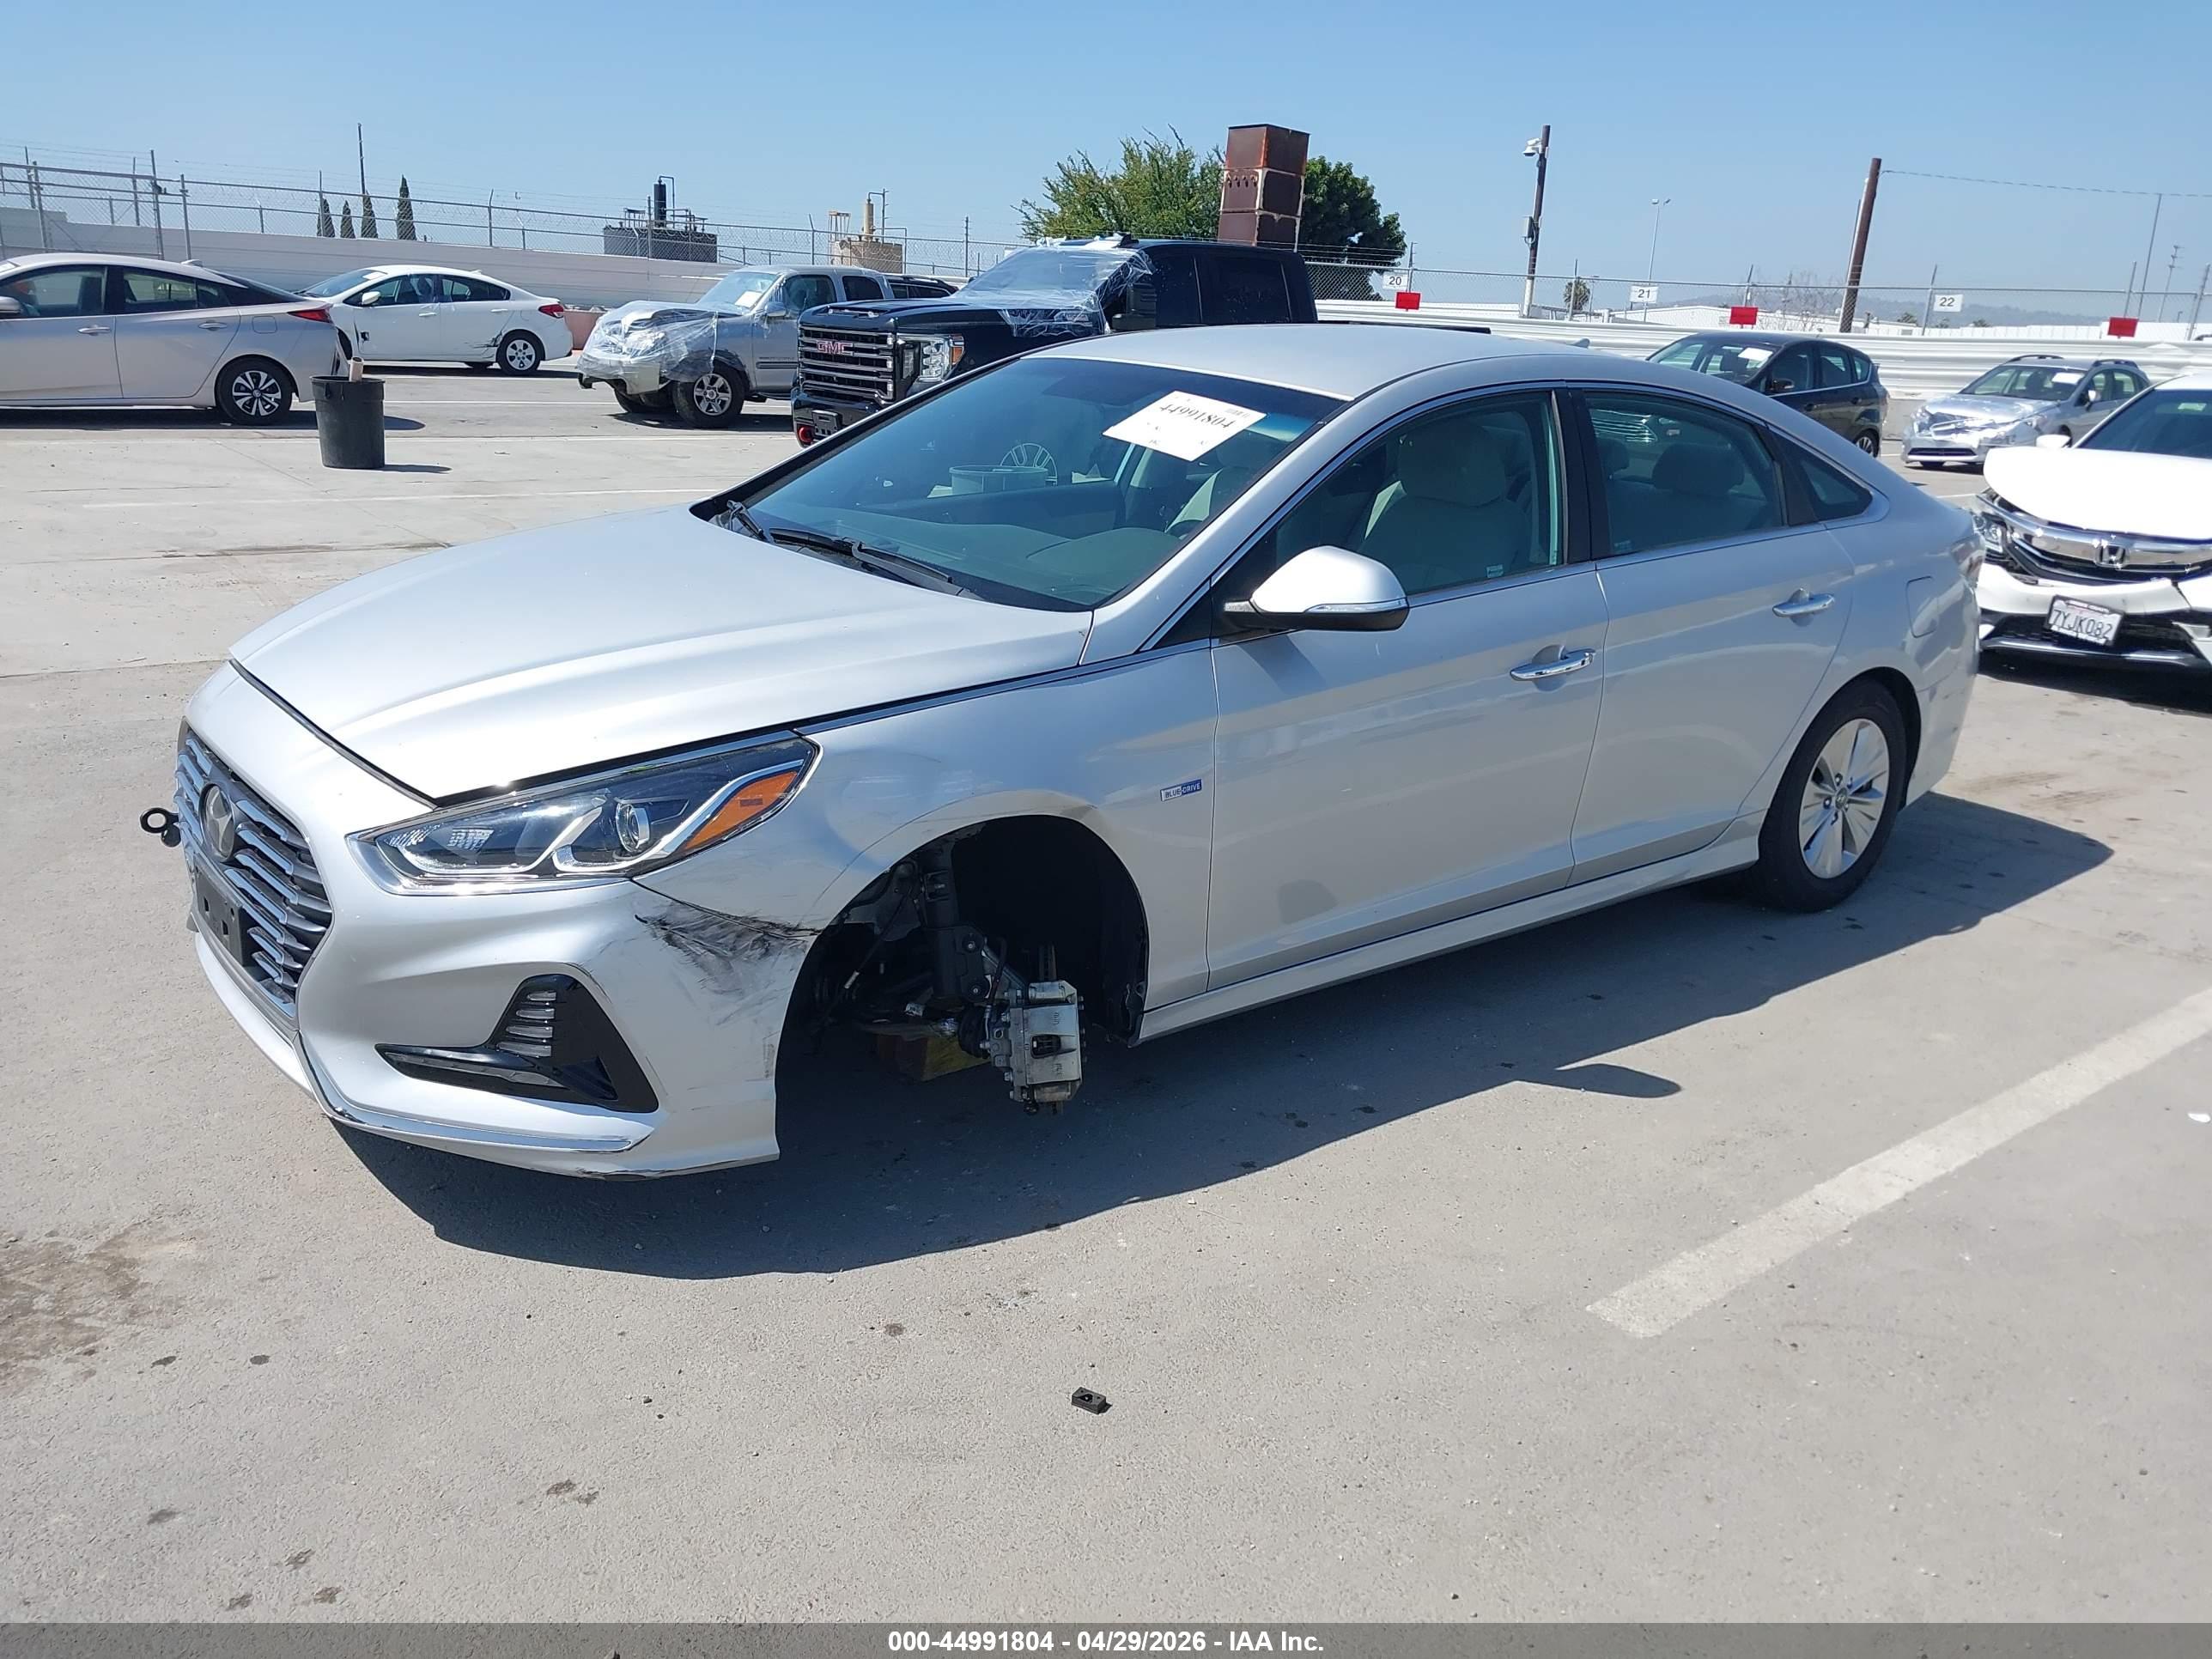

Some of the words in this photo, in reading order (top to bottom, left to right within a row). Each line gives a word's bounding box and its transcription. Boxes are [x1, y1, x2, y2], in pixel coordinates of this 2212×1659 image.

[1389, 276, 1402, 286] 20
[1638, 289, 1650, 299] 21
[1939, 297, 1955, 307] 22
[816, 340, 854, 356] GMC
[1160, 404, 1236, 428] 44991804
[2049, 609, 2112, 640] 7YJK082
